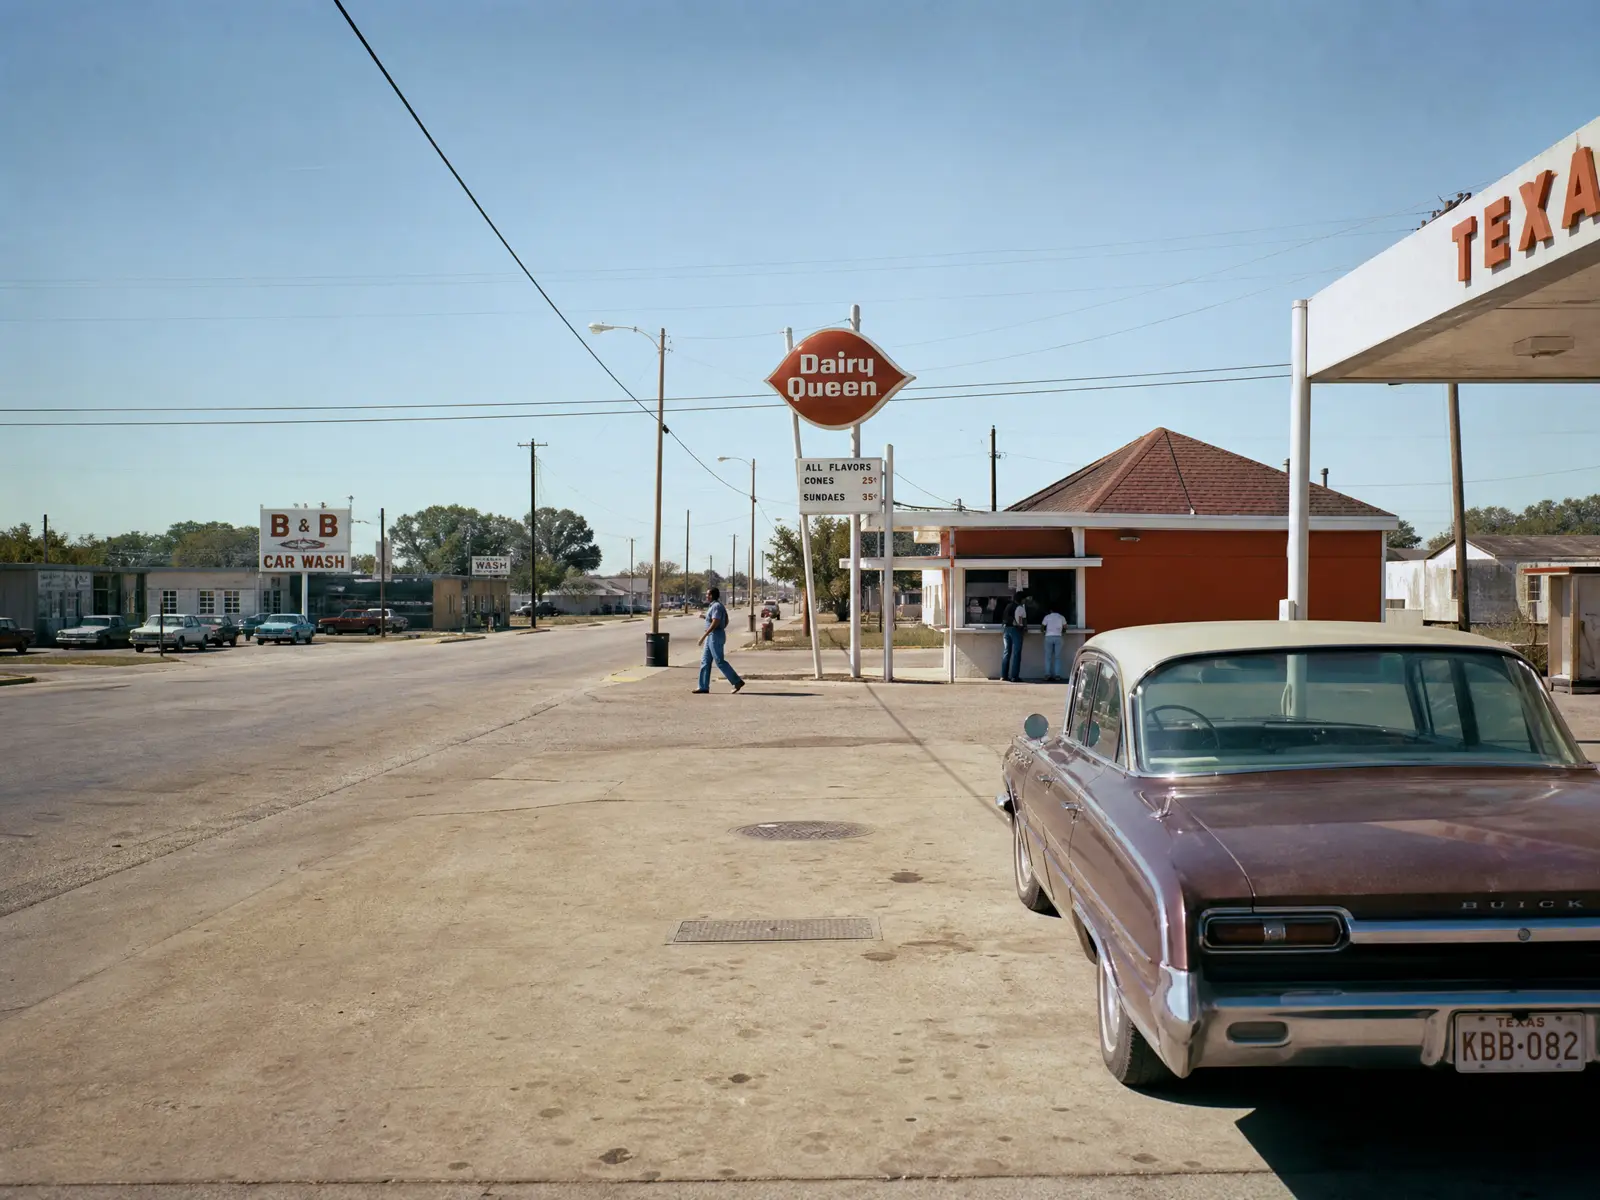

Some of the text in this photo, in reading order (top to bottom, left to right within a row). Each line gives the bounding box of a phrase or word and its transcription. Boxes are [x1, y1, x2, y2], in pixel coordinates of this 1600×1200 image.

[1452, 146, 1600, 282] TEXA
[800, 351, 874, 377] Dairy
[787, 377, 877, 401] Queen
[805, 463, 872, 472] ALL FLAVORS
[804, 477, 834, 485] CONES
[803, 493, 845, 502] SUNDAES
[270, 514, 338, 537] B & B
[263, 555, 345, 569] CAR WASH
[475, 561, 507, 570] WASH
[1461, 899, 1583, 909] BUICK
[1496, 1017, 1545, 1028] TEXAS
